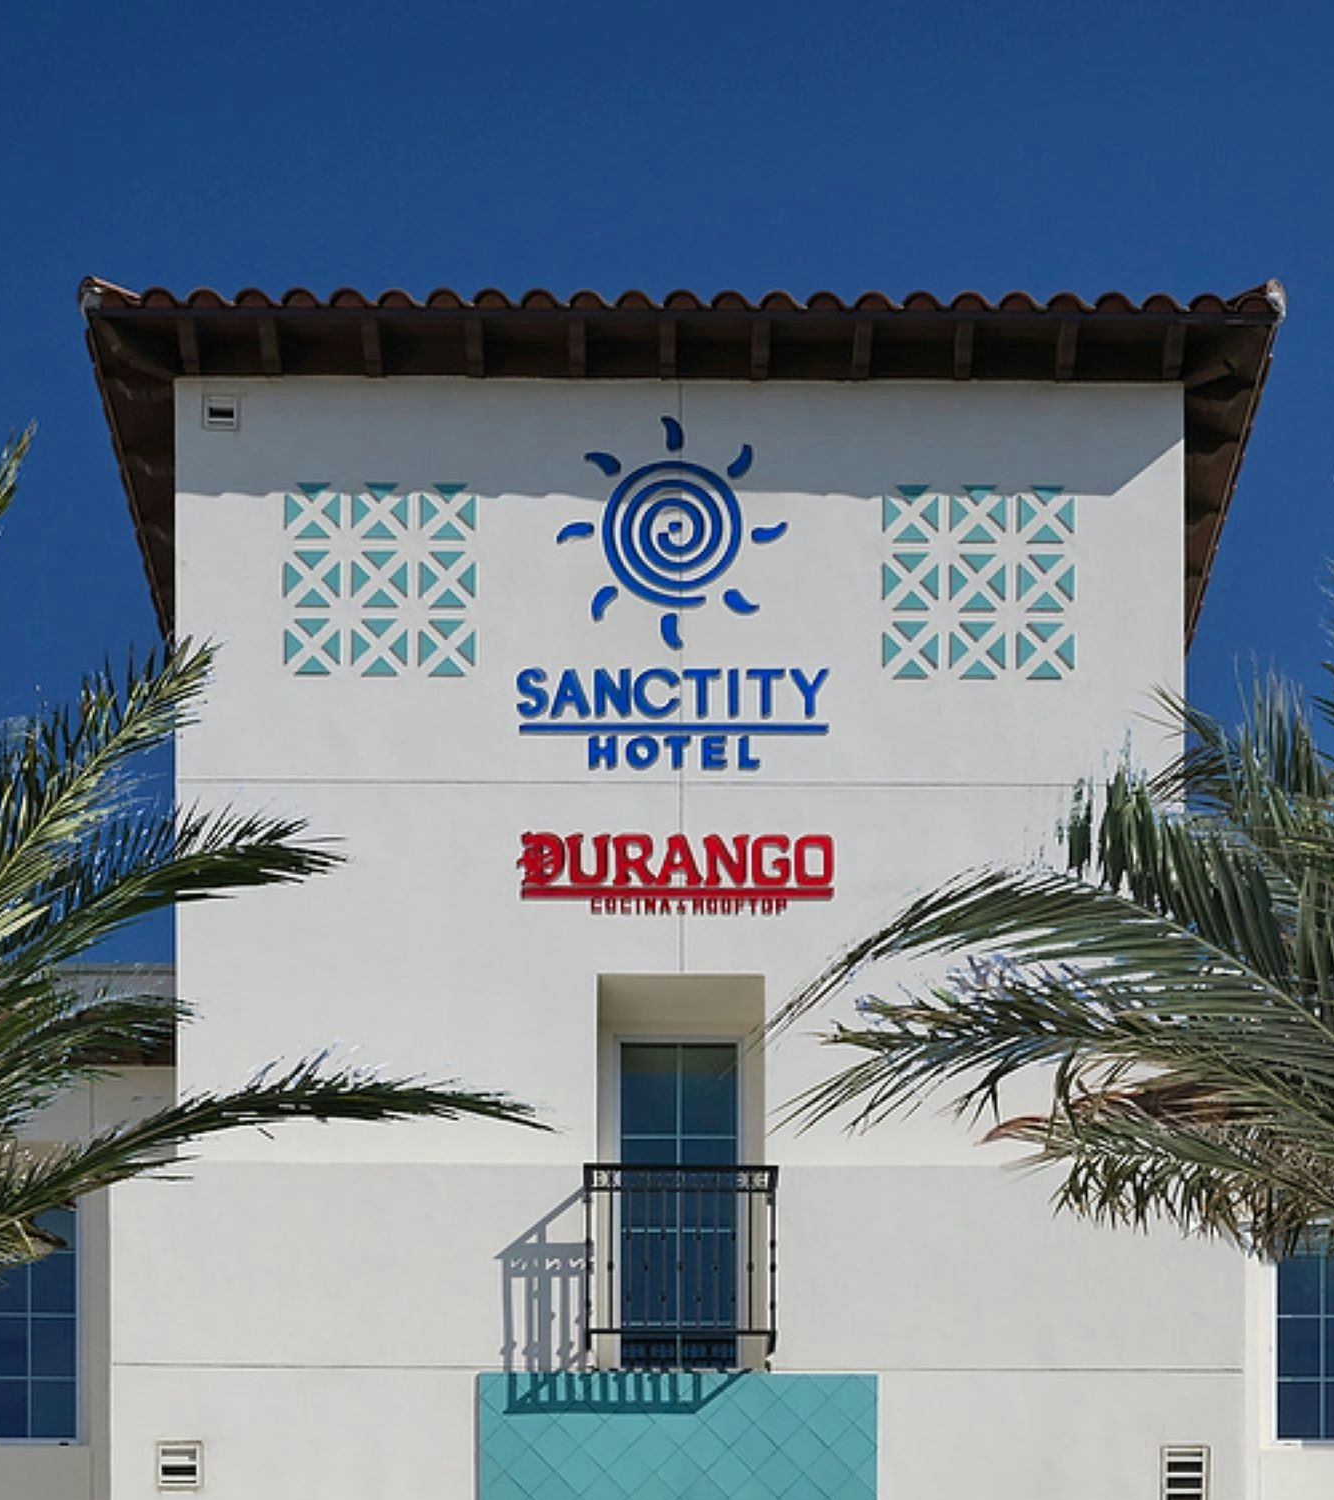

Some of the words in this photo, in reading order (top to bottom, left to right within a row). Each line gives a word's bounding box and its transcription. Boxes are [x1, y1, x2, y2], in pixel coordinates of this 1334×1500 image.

[516, 668, 829, 718] SANCTITY
[587, 736, 760, 769] HOTEL
[517, 832, 835, 887] DURANGO
[590, 898, 671, 915] COCINA
[691, 898, 788, 915] ROOFTOP
